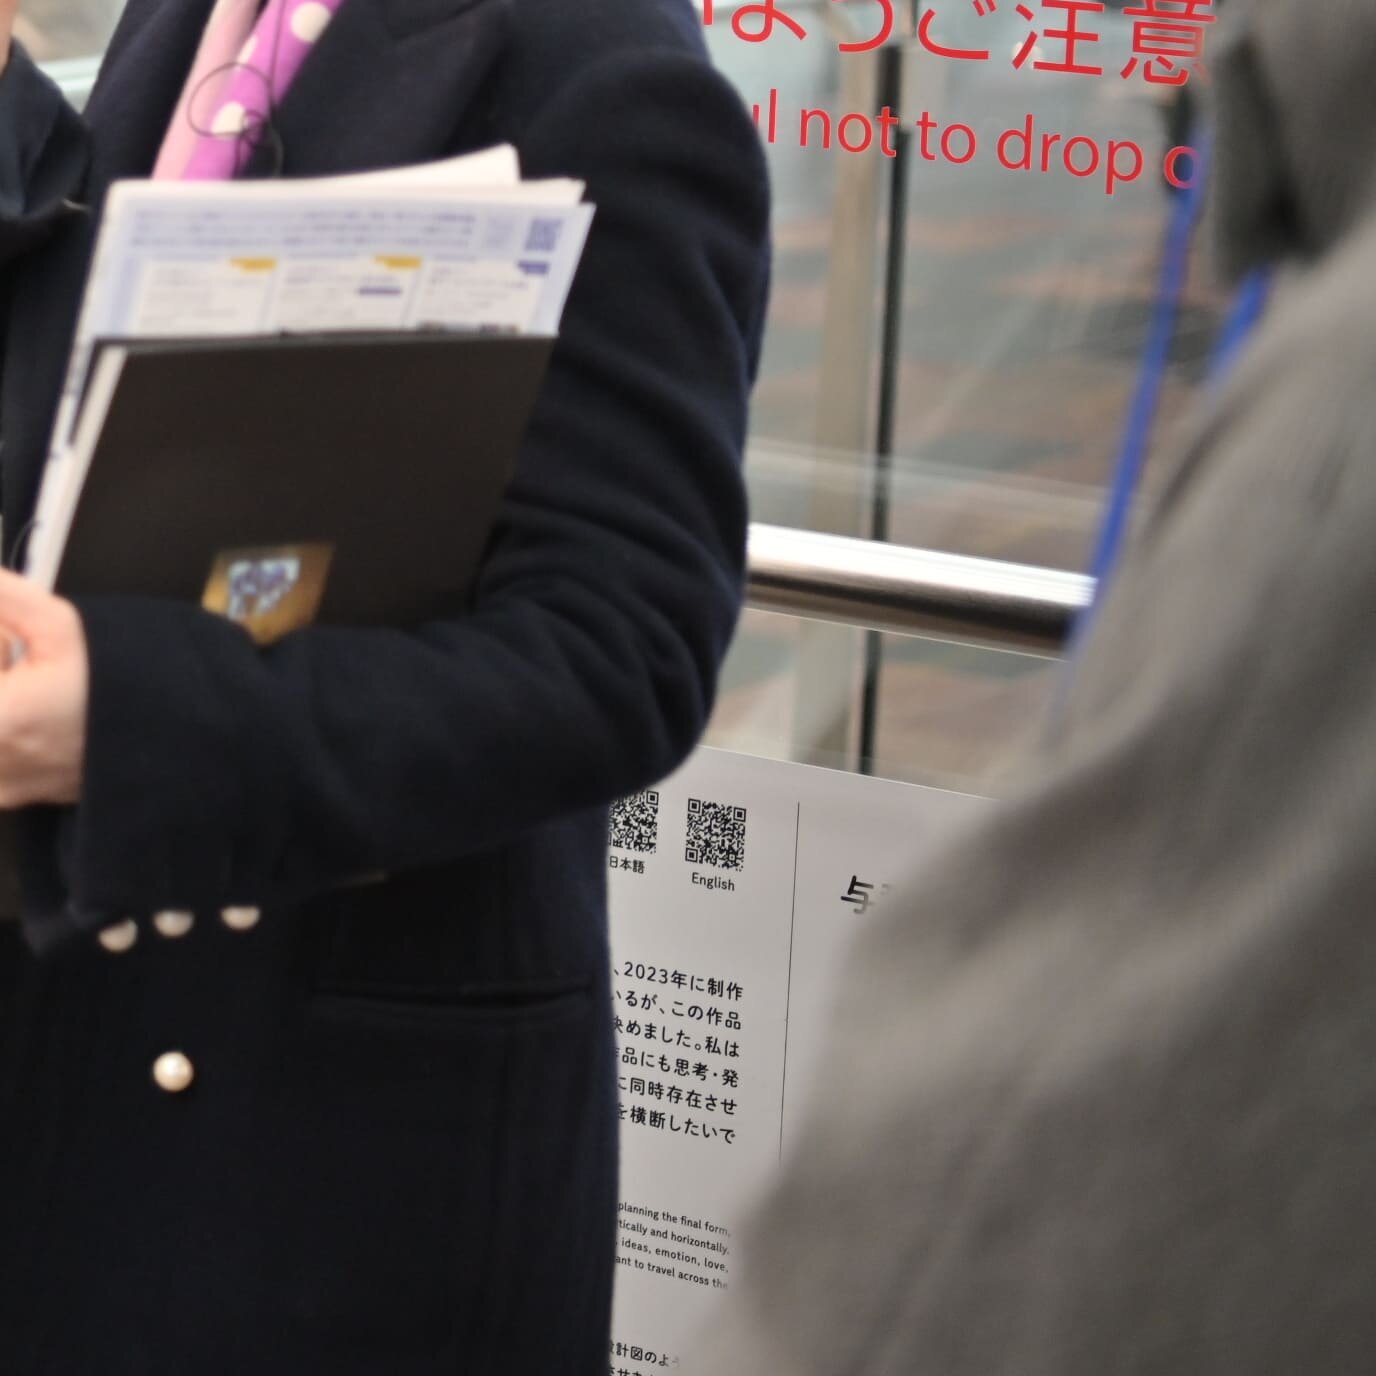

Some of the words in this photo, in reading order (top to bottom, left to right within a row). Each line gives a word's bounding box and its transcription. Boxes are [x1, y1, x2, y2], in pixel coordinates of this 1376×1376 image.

[799, 106, 898, 158] not
[916, 111, 978, 164] to
[996, 114, 1144, 195] drop
[609, 855, 646, 874] 日本語
[691, 871, 736, 892] English
[840, 874, 893, 915] 与
[615, 1046, 739, 1088] 品にも思考・発
[618, 1219, 648, 1236] tically
[650, 1228, 668, 1239] and
[662, 1211, 678, 1224] the
[681, 1215, 702, 1230] final
[615, 1255, 632, 1266] ant
[634, 1258, 645, 1270] to
[647, 1262, 675, 1277] travel
[678, 1271, 710, 1286] across
